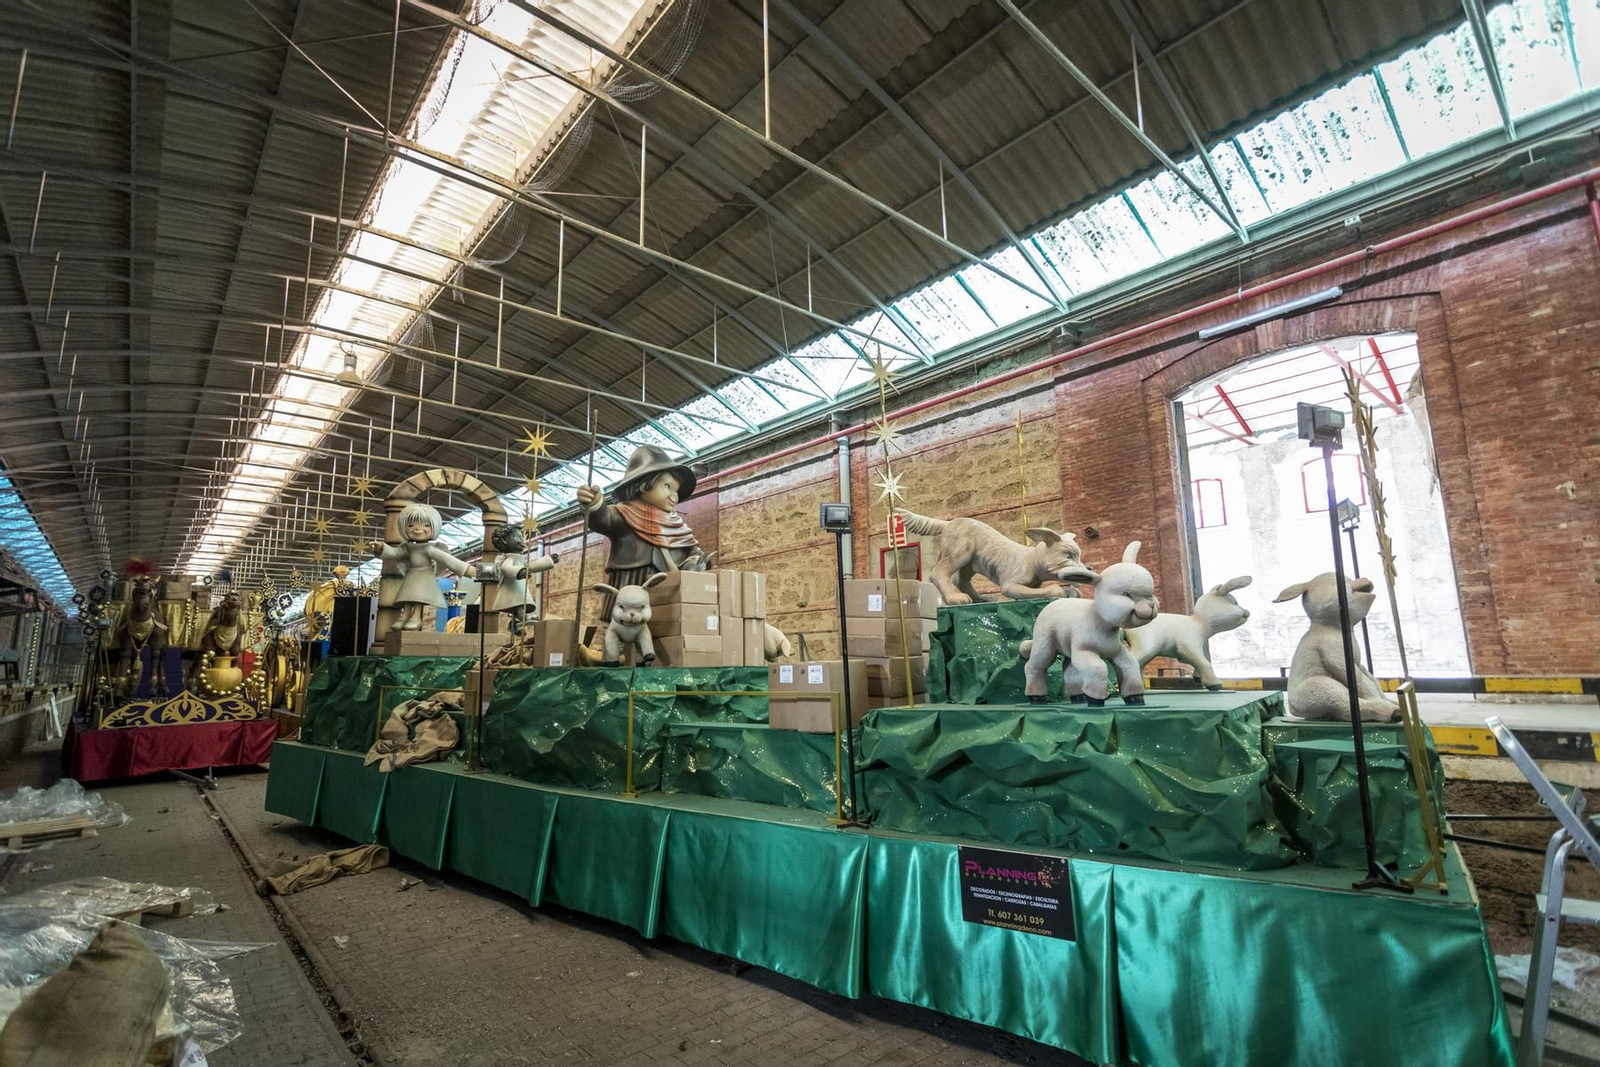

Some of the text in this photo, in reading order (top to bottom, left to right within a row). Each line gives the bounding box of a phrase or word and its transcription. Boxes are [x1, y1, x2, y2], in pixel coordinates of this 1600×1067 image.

[965, 872, 1037, 886] DECORADOS
[970, 886, 995, 894] DECORADOS
[998, 911, 1011, 919] 607
[1013, 913, 1027, 922] 361
[1030, 916, 1044, 925] 039
[983, 919, 1052, 936] www.planningdeco.com
